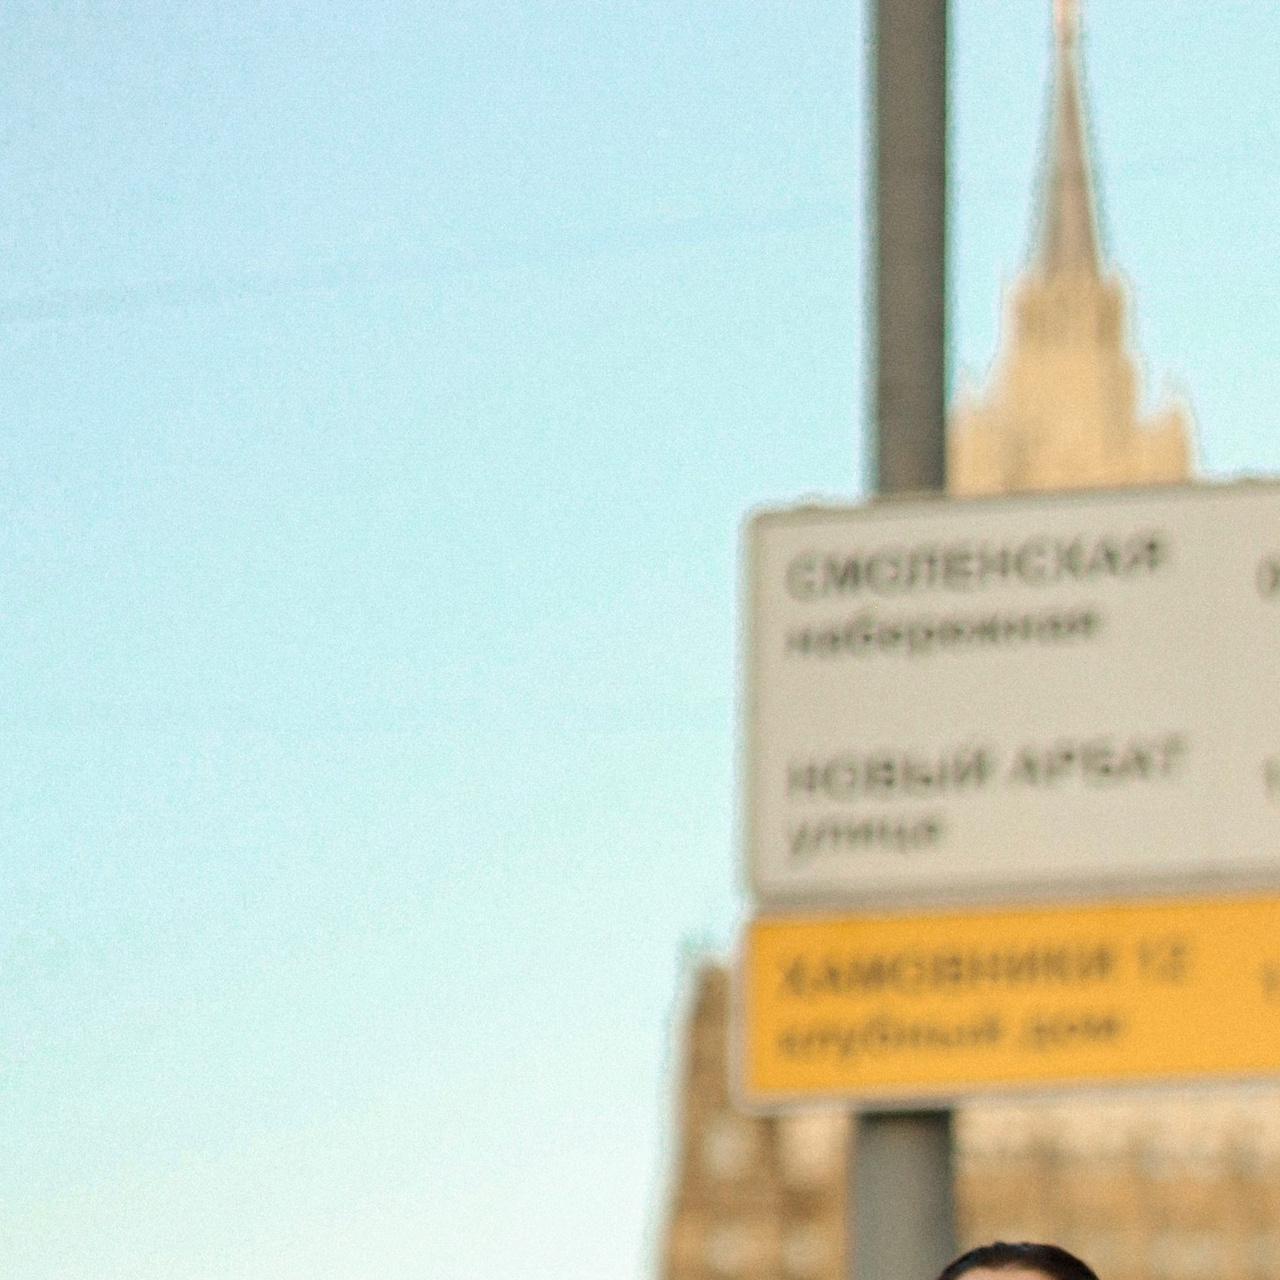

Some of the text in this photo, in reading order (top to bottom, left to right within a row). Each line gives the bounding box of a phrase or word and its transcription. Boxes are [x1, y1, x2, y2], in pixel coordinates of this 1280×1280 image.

[785, 528, 1168, 601] СМОЛЕНСКАЯ
[786, 733, 1188, 801] НОВЫЙ АРБАТ
